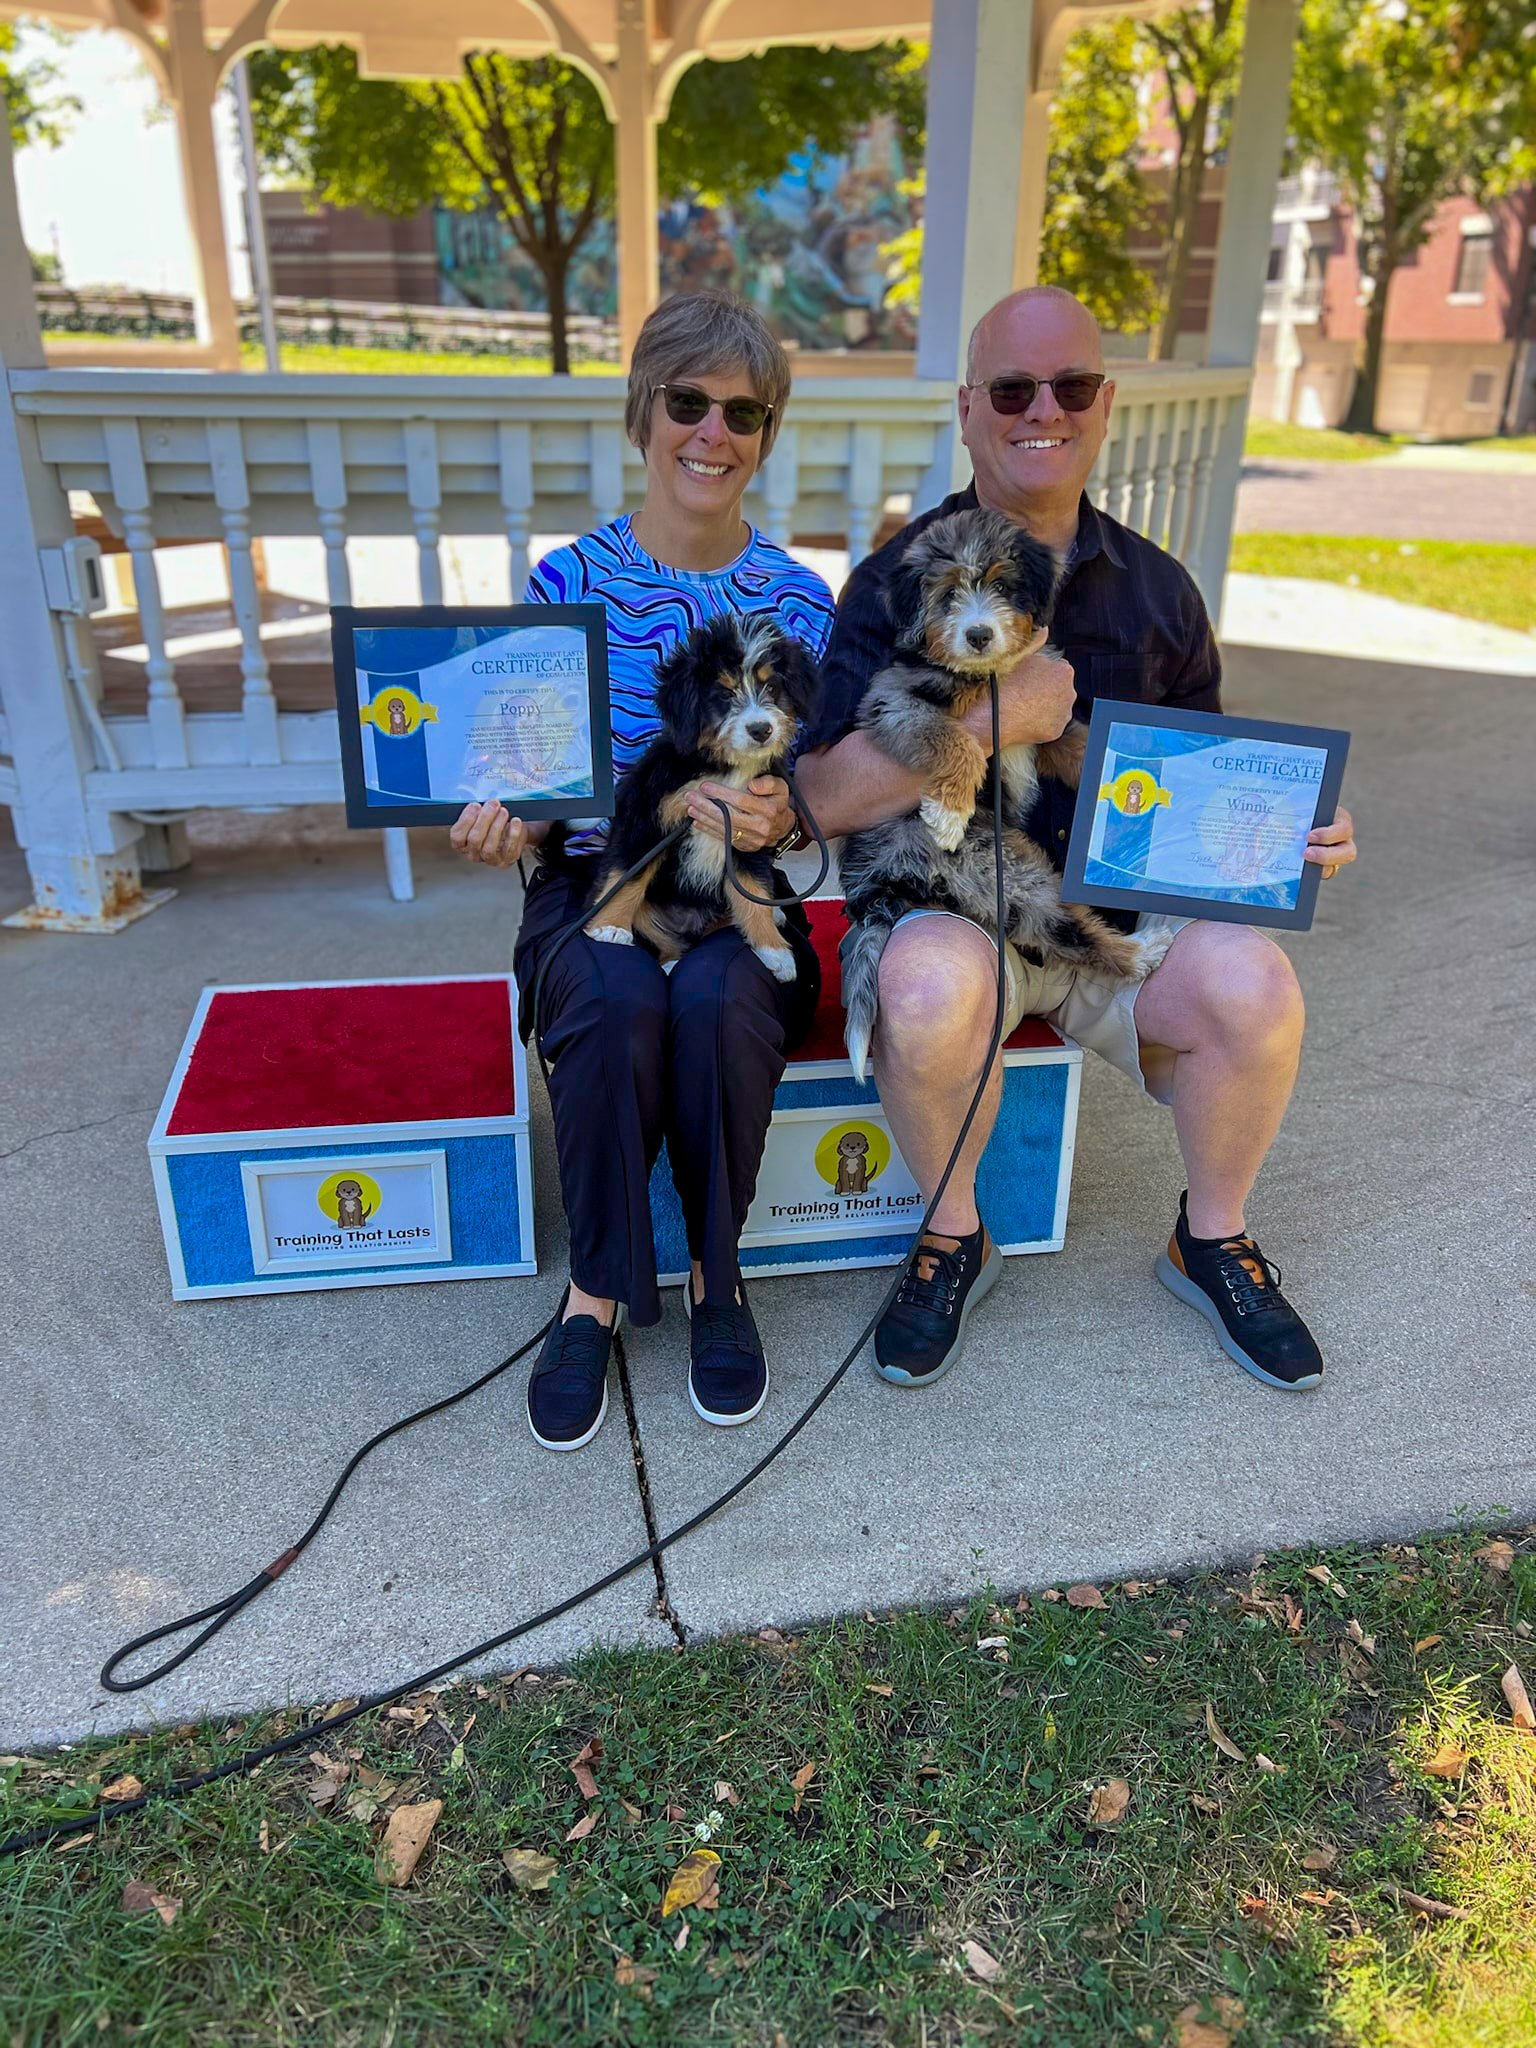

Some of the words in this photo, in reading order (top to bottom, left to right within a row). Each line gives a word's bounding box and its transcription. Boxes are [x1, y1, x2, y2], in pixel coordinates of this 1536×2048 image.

[471, 657, 586, 675] CERTIFICATE
[500, 703, 543, 717] Poppy
[1212, 756, 1323, 779] CERTIFICATE
[1227, 798, 1274, 814] Winnie
[769, 1201, 839, 1217] Training
[844, 1196, 882, 1211] That
[790, 1215, 841, 1223] REDEFINING
[845, 1209, 911, 1218] RELATIONSHIPS
[274, 1233, 343, 1247] Training
[346, 1229, 383, 1242] That
[388, 1226, 431, 1239] Lasts
[349, 1240, 412, 1249] RELATIONSHIPS
